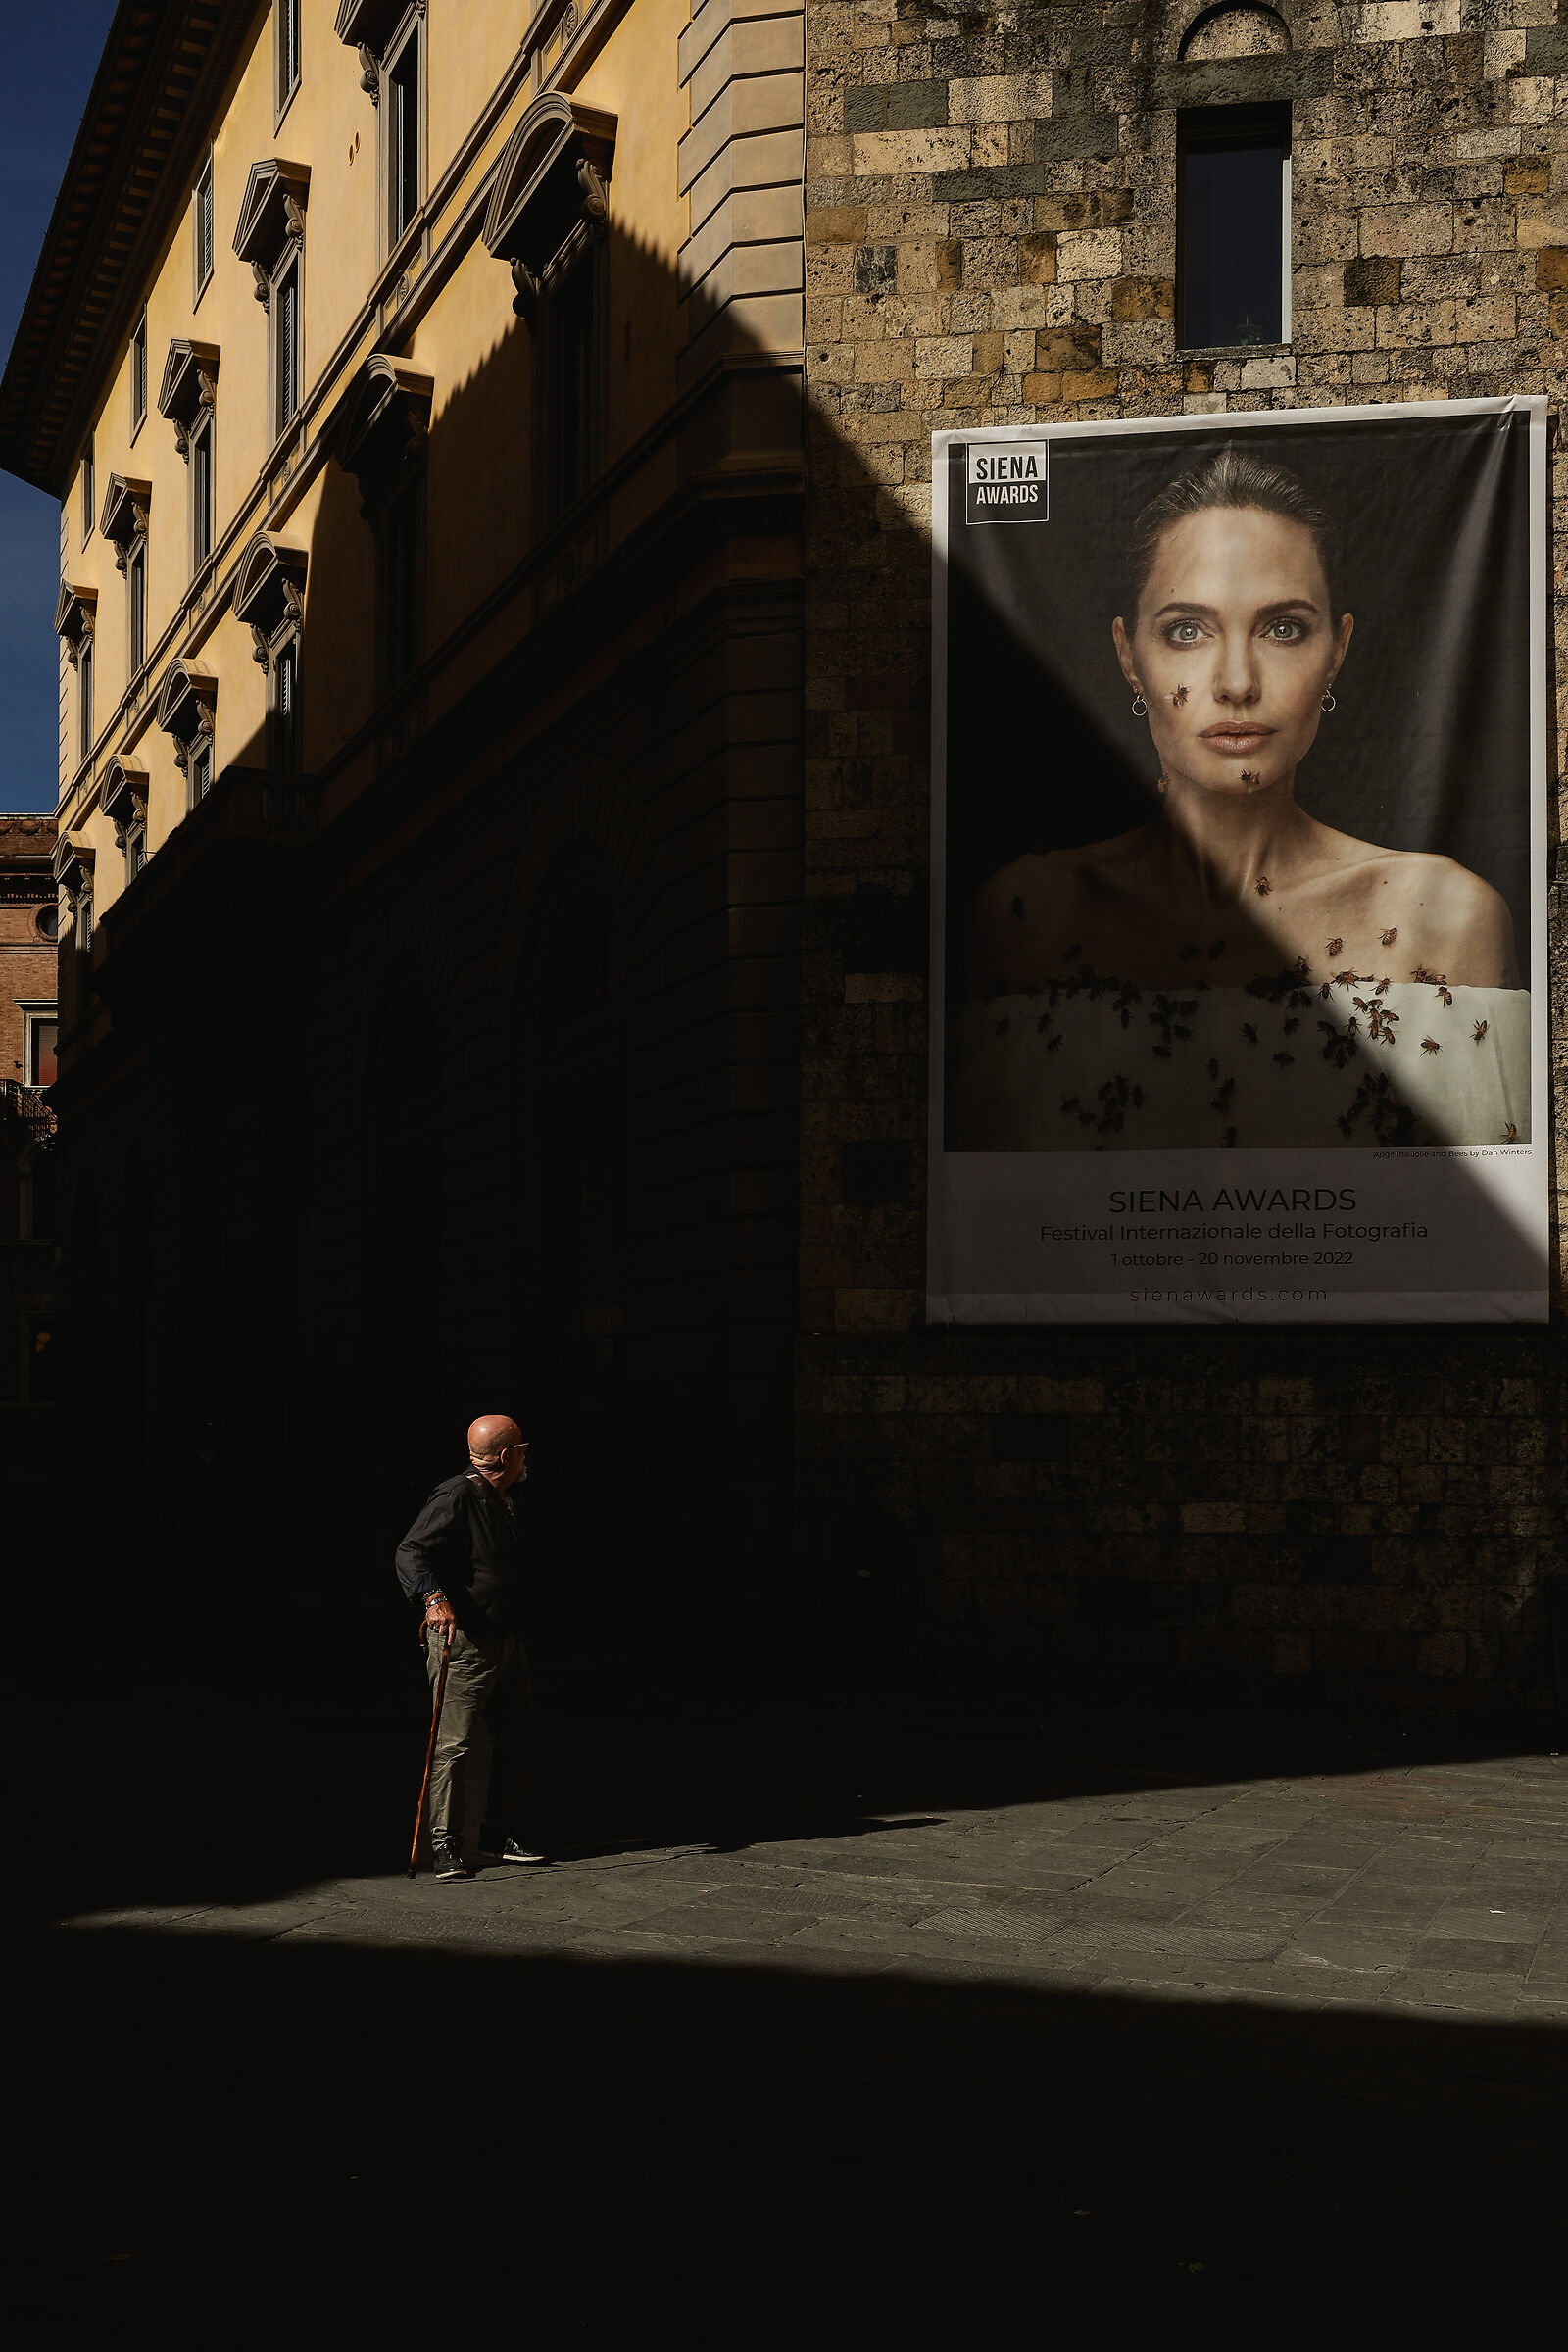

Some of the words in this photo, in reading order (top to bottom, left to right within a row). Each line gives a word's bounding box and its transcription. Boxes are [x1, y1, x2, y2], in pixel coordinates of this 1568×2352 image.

[976, 456, 1038, 480] SIENA
[976, 484, 1039, 505] AWARDS
[1373, 1151, 1409, 1159] Angelina
[1431, 1150, 1446, 1158] and
[1469, 1150, 1480, 1158] by
[1499, 1148, 1533, 1156] Winters
[1109, 1190, 1203, 1213] SIENA
[1212, 1188, 1356, 1211] AWARDS
[1041, 1225, 1113, 1241] Festival
[1121, 1223, 1262, 1240] Internazionale
[1268, 1223, 1316, 1239] della
[1323, 1222, 1428, 1242] Fotografia
[1110, 1253, 1117, 1266] 1
[1122, 1252, 1184, 1267] ottobre
[1198, 1252, 1218, 1265] 20
[1224, 1251, 1309, 1265] novembre
[1313, 1251, 1354, 1265] 2022
[1130, 1287, 1327, 1301] sienawards.com
